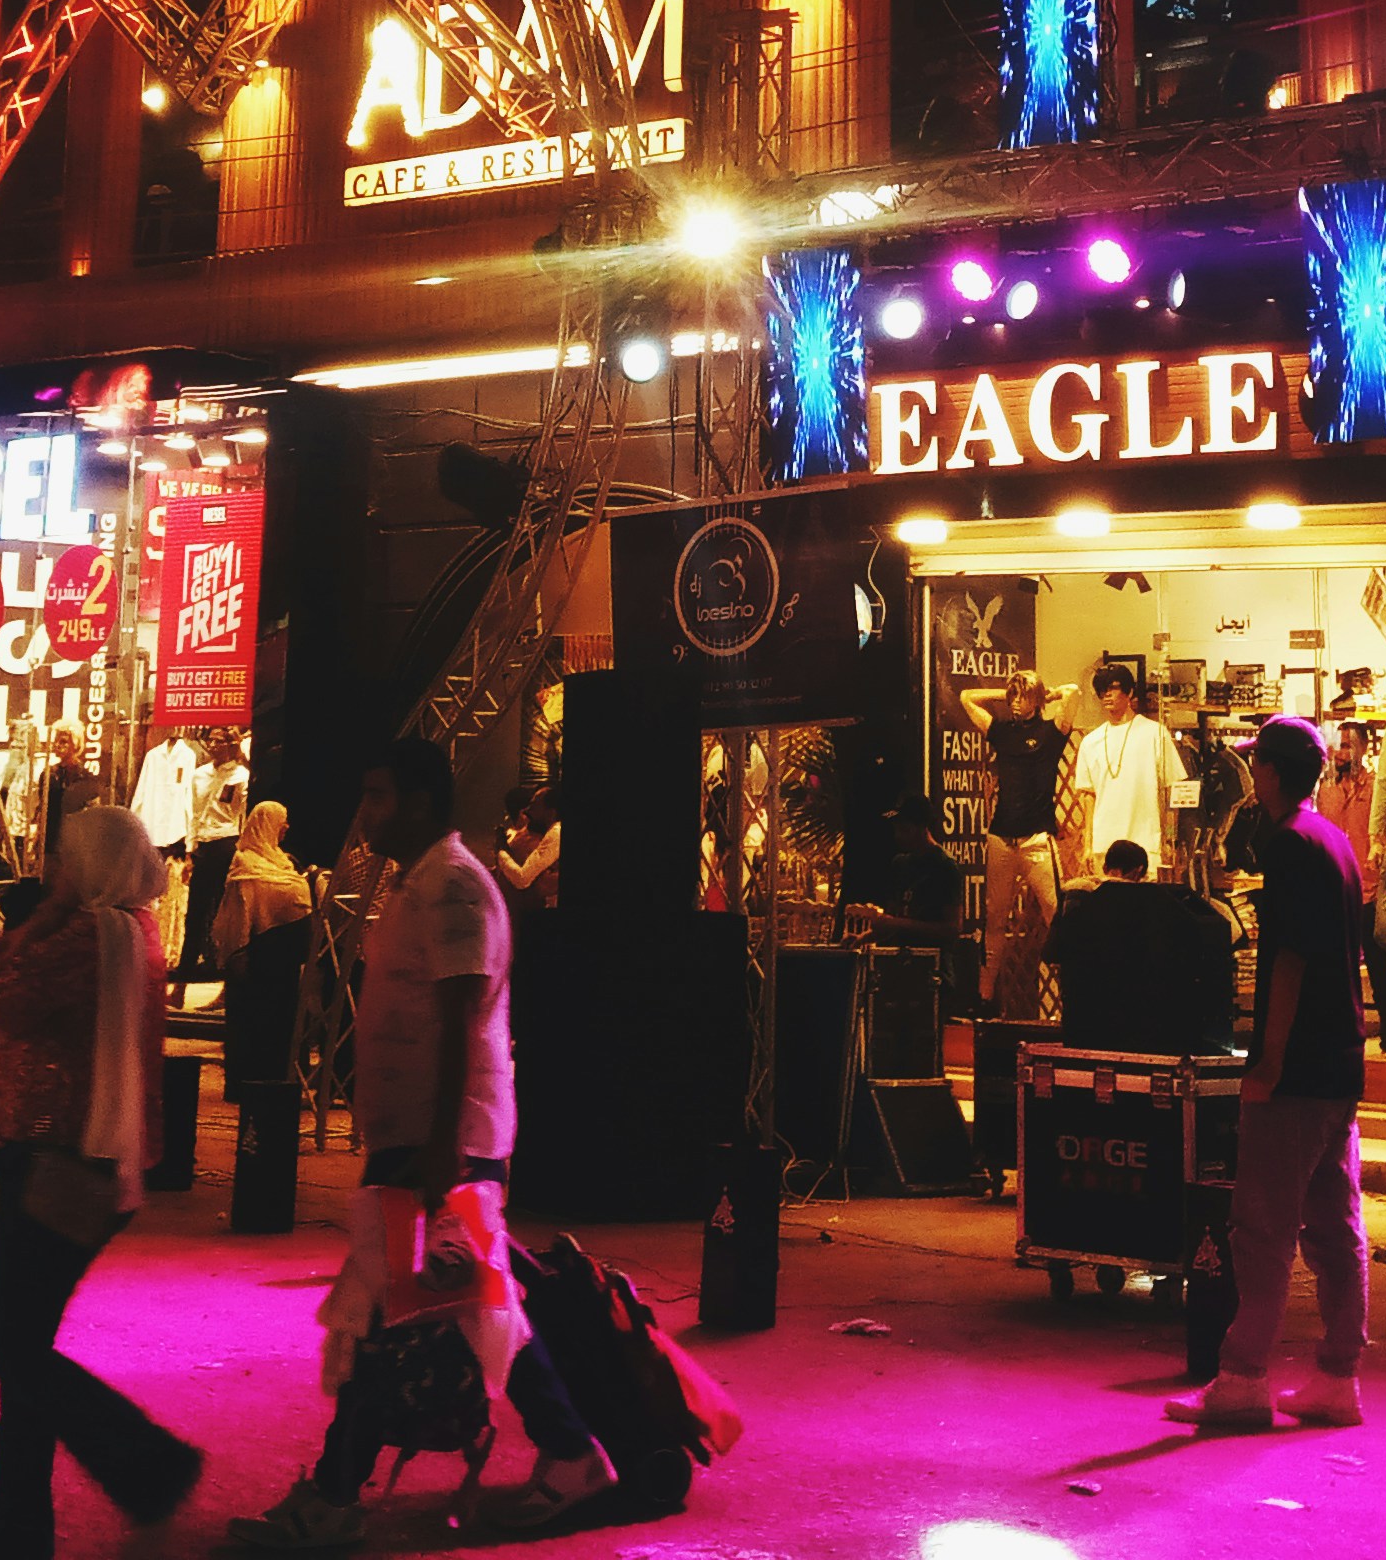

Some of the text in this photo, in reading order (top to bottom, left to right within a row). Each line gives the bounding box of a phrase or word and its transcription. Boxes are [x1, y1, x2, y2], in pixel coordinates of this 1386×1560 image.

[352, 163, 426, 198] CAFE
[446, 160, 461, 186] &
[871, 351, 1278, 475] EAGLE
[192, 544, 225, 579] BUY
[80, 554, 114, 615] 2
[190, 569, 221, 603] GET
[689, 573, 702, 599] dj
[176, 583, 244, 655] FREE
[167, 672, 187, 686] BUY
[195, 671, 213, 685] GET
[222, 670, 246, 684] FREE
[951, 649, 1019, 678] EAGLE
[166, 693, 186, 707] BUY
[193, 692, 212, 706] GET
[221, 692, 245, 706] FREE
[943, 769, 977, 791] WHAT
[943, 796, 992, 835] STYL
